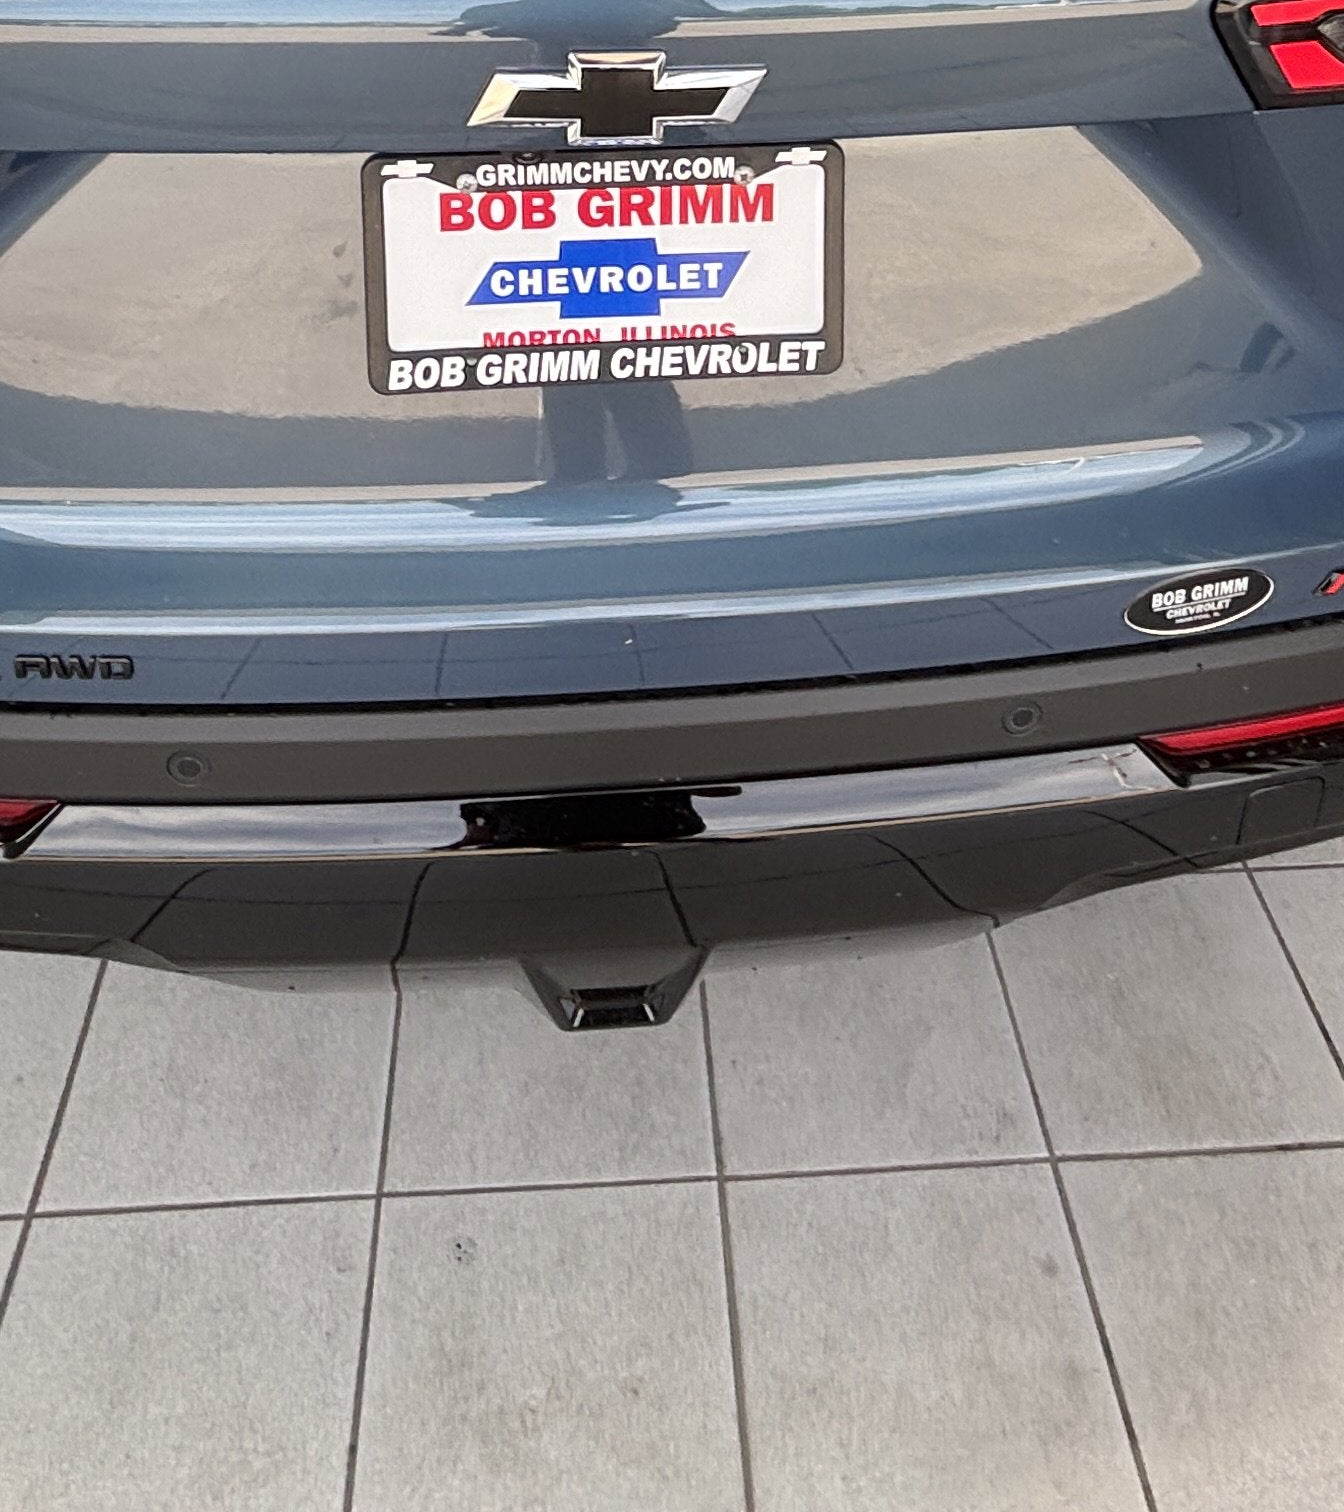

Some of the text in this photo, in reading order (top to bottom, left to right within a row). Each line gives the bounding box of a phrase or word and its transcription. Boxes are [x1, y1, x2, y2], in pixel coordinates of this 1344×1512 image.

[475, 157, 736, 187] GRIMMCHEVY.COM
[439, 183, 775, 232] BOB GRIMM
[490, 261, 724, 296] CHEVROLET
[387, 341, 826, 391] BOB GRIMM CHEVROLET
[1151, 576, 1250, 609] BOB GRIMM
[1165, 598, 1232, 620] CHEVROLET
[14, 653, 136, 681] AWD
